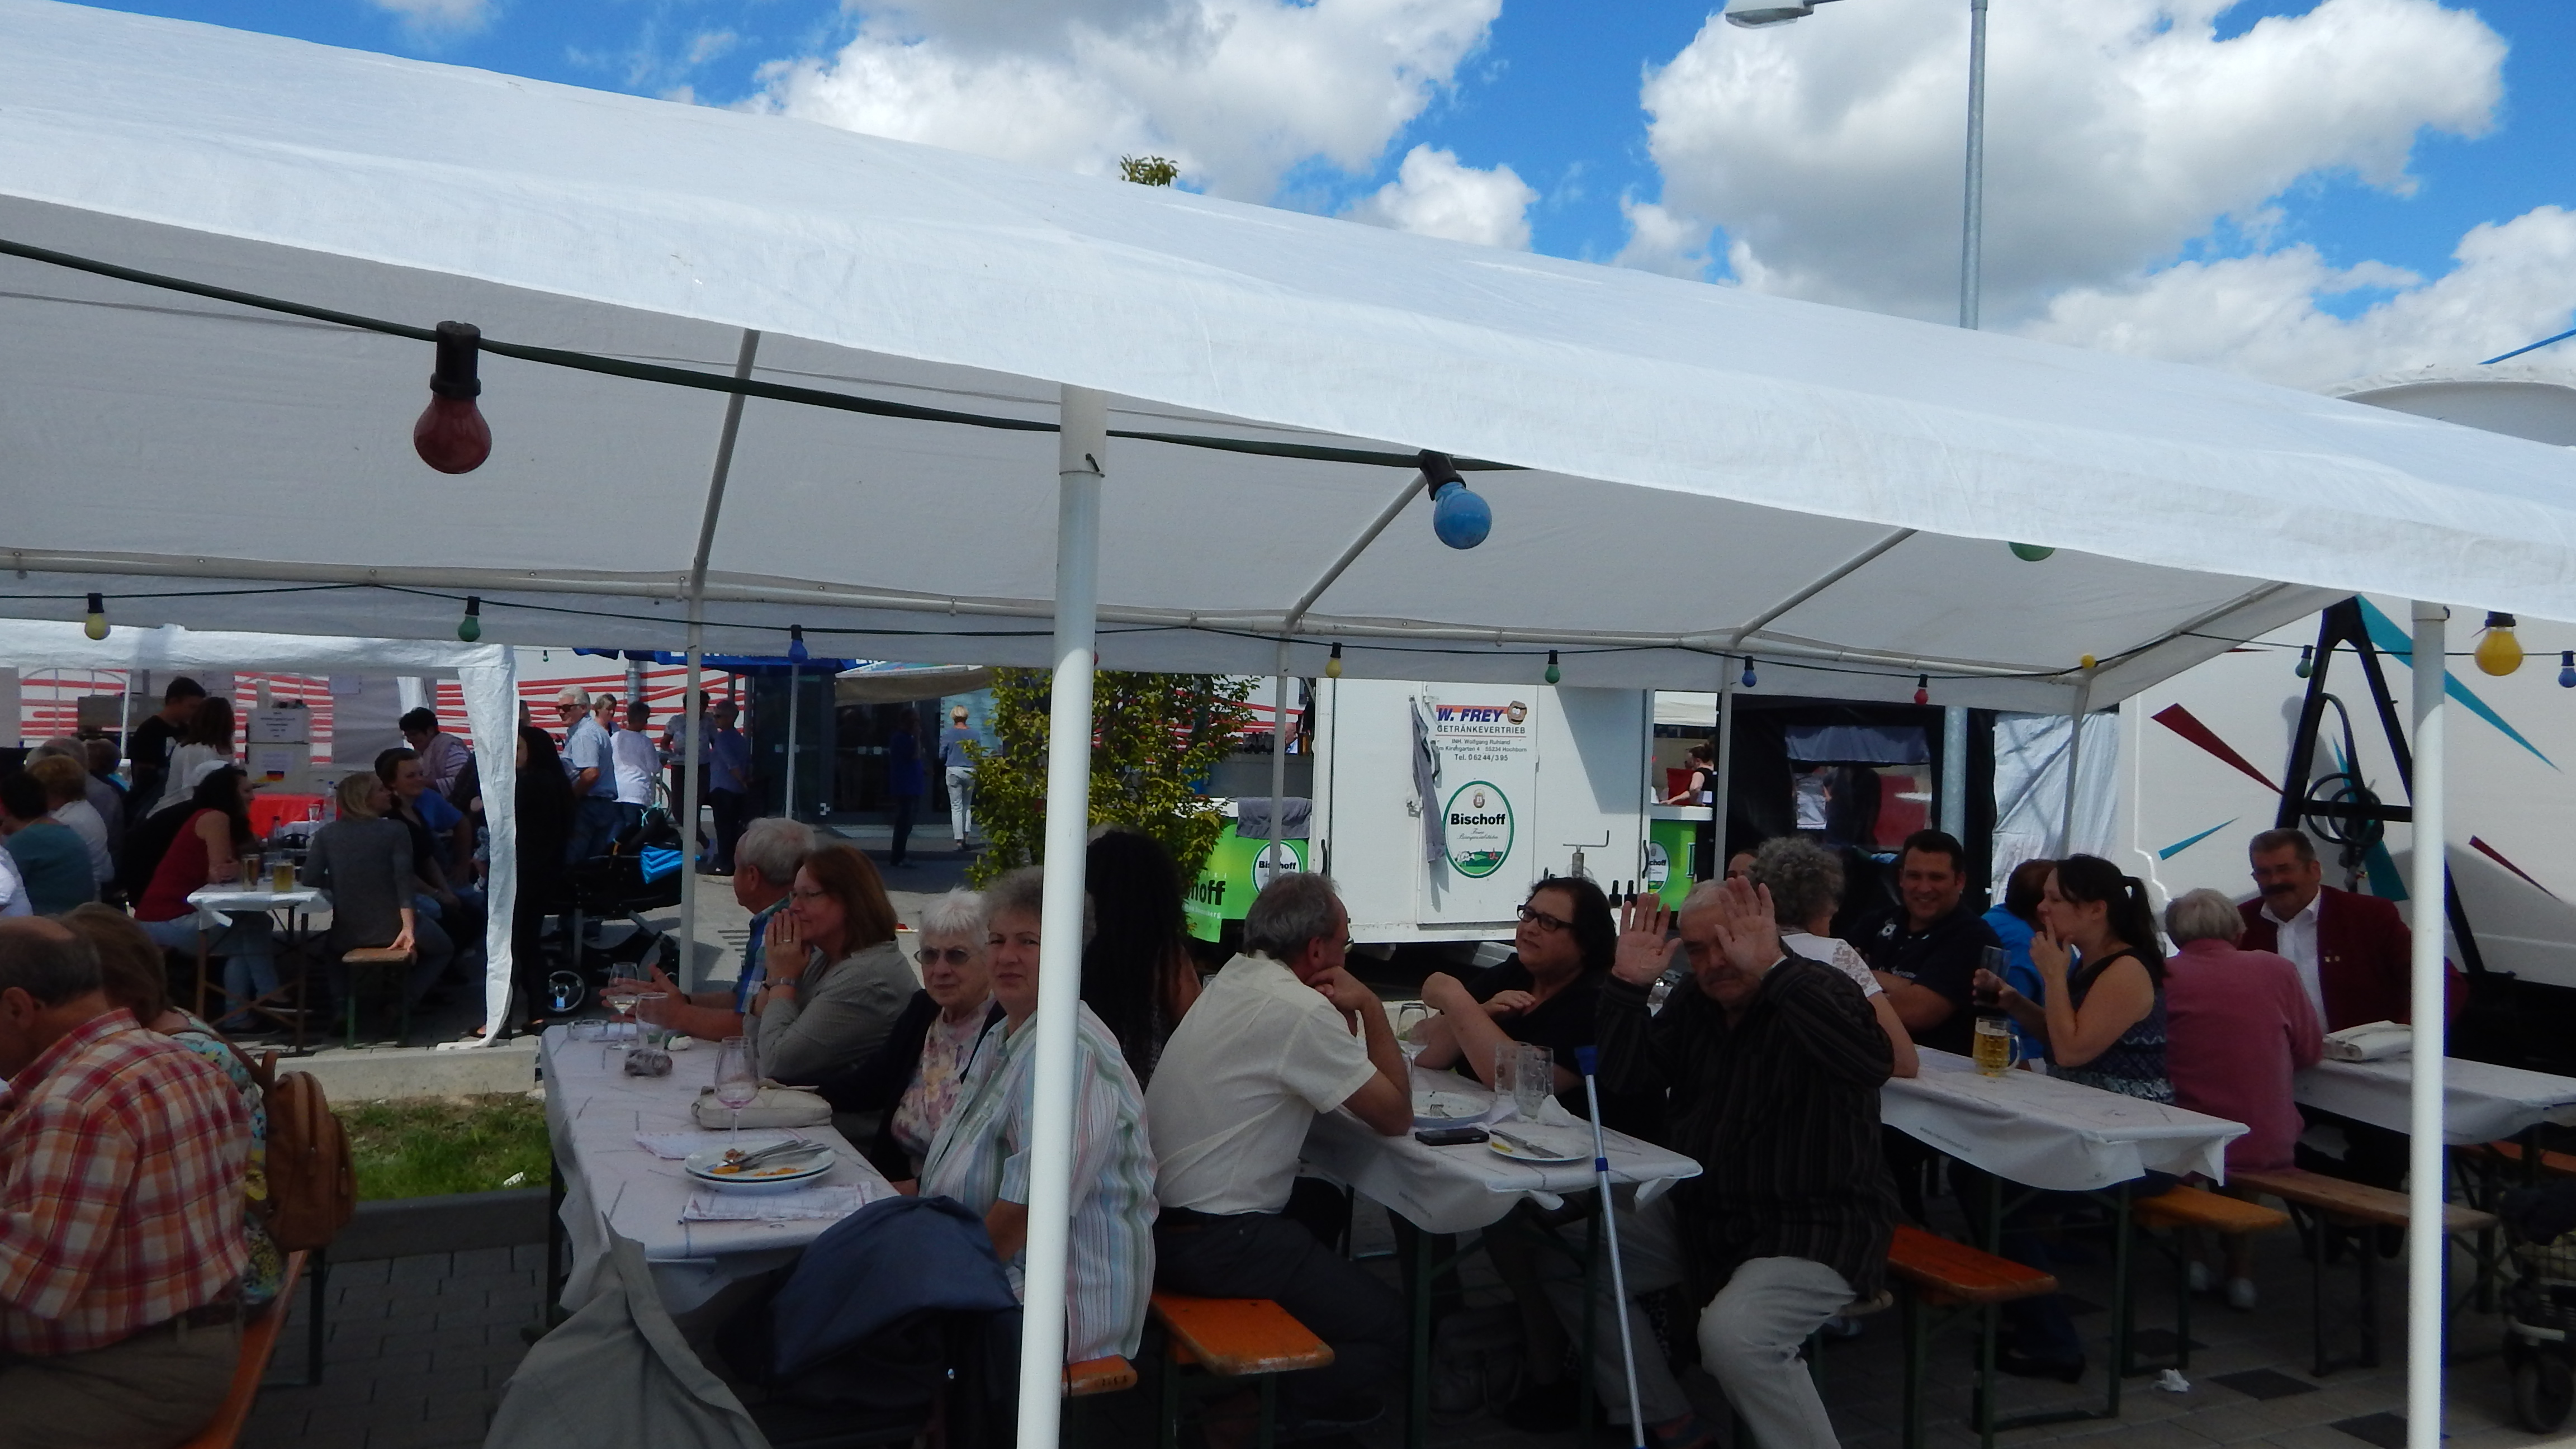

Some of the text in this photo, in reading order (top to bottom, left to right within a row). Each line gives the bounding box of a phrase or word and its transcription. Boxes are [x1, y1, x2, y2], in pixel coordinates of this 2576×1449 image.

[1438, 708, 1504, 722] W. FREY
[1437, 724, 1526, 733] GETRÄNKEVERTRIEB
[1451, 813, 1505, 825] Bischoff
